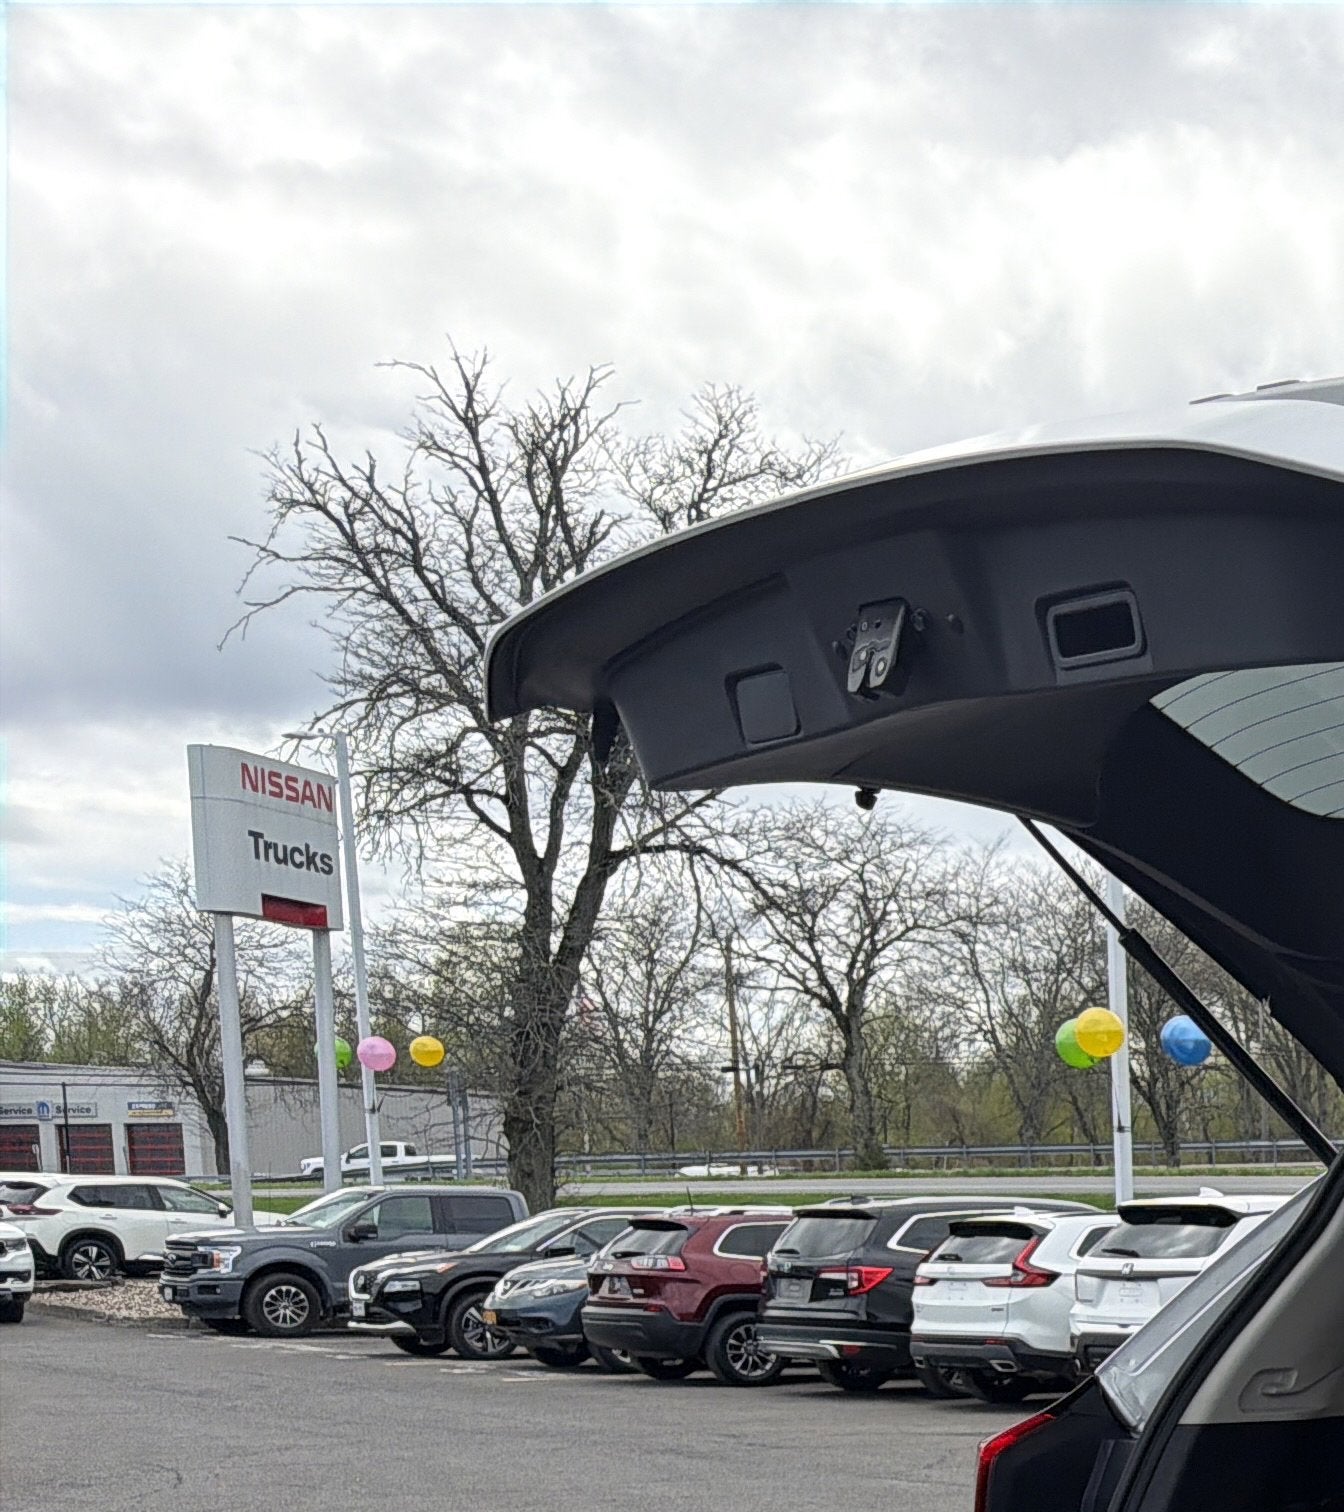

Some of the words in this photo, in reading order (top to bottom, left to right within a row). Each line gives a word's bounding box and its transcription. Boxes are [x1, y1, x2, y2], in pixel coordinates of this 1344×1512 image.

[240, 761, 333, 813] NISSAN
[247, 829, 334, 876] Trucks
[55, 1104, 92, 1114] Srvice
